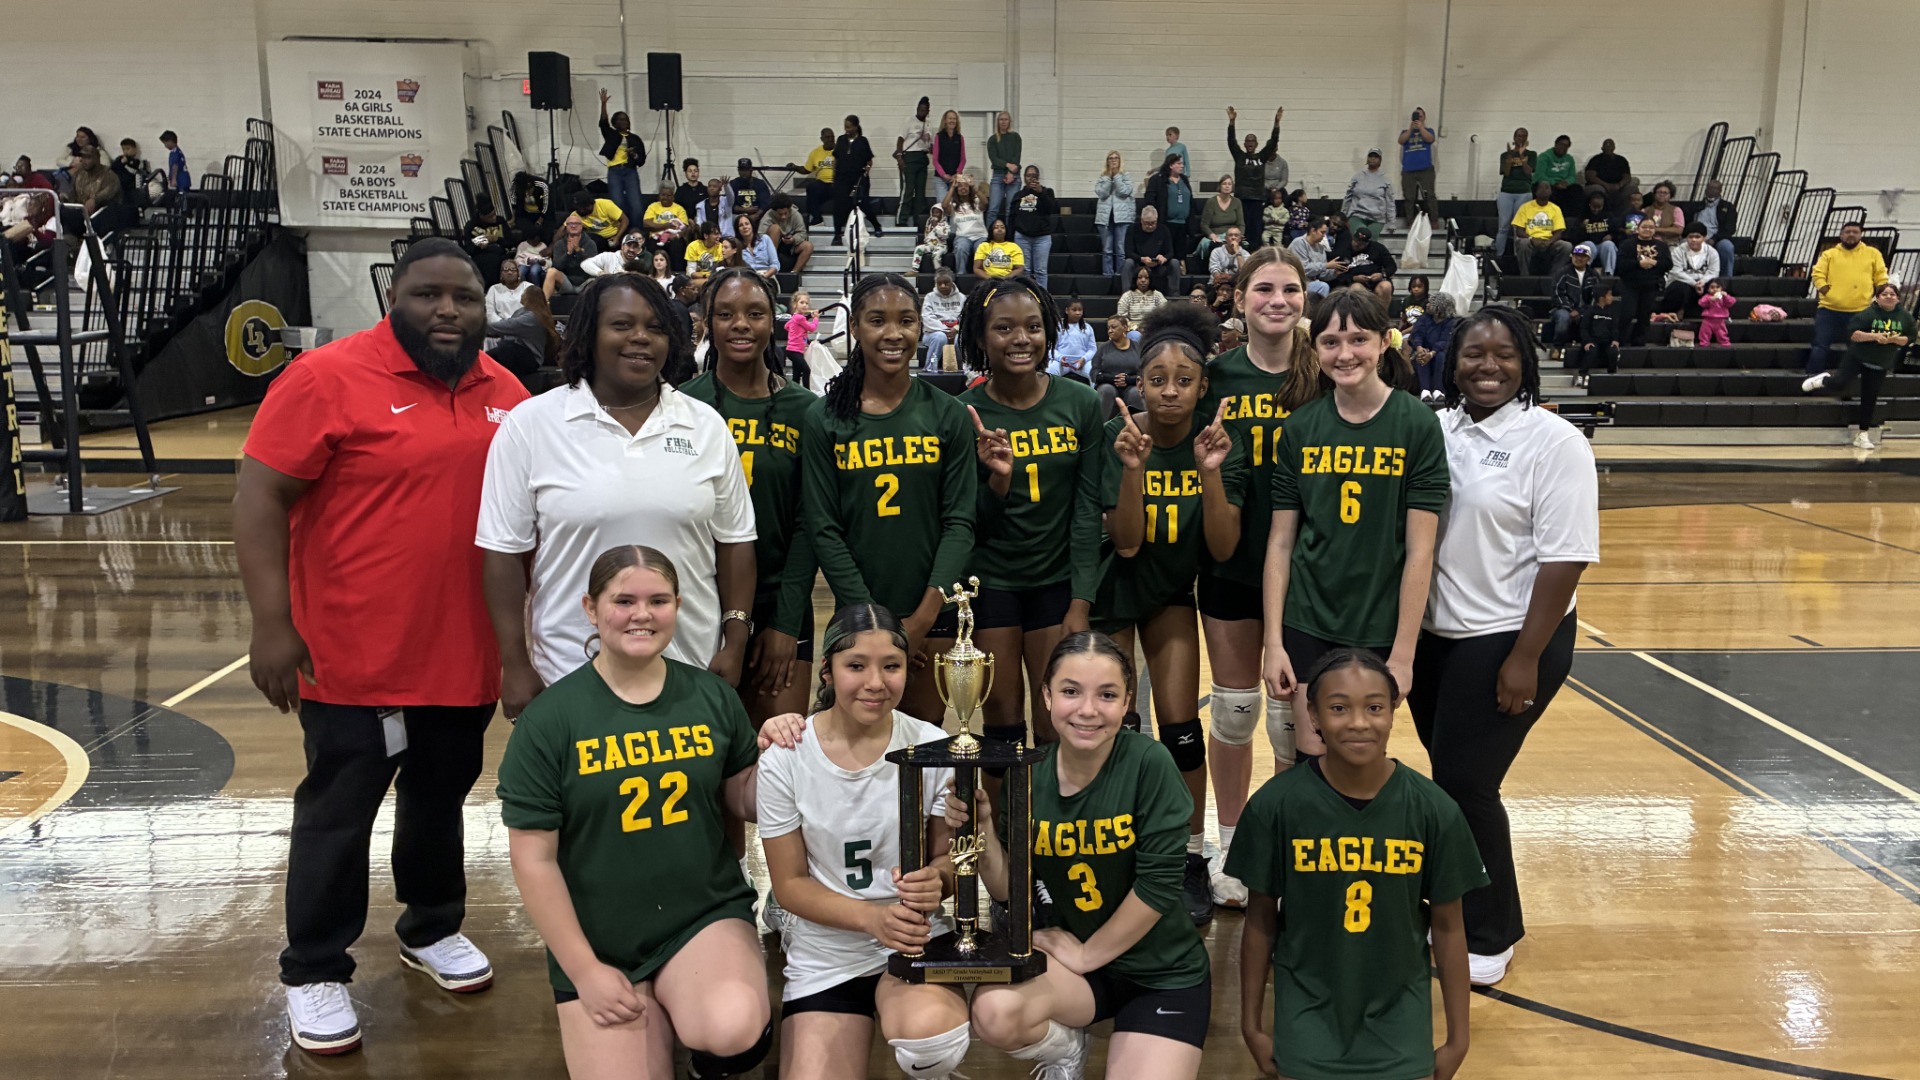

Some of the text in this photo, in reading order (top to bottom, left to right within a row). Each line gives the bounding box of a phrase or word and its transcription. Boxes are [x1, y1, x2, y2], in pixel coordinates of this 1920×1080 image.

[345, 102, 393, 113] 6A GIRLS
[354, 90, 382, 99] 2024
[318, 127, 422, 139] STATE CHAMPIONS
[335, 114, 404, 126] BASKETBALL
[350, 177, 396, 187] 6A BOYS
[359, 165, 386, 174] 2024
[322, 201, 426, 213] STATE CHAMPIONS
[339, 189, 408, 200] BASKETBALL
[1221, 393, 1291, 420] EAGL
[663, 446, 700, 457] VOLLEYBALL
[665, 437, 694, 450] FHSA
[727, 417, 800, 454] GLES
[1010, 426, 1079, 458] GLES
[834, 435, 941, 470] EAGLES
[1301, 445, 1407, 476] EAGLES
[1486, 450, 1511, 462] FHSA
[874, 473, 901, 518] 2
[1025, 462, 1041, 503] 1
[1340, 480, 1362, 524] 6
[1145, 503, 1179, 544] 11
[575, 724, 715, 776] EAGLES
[618, 770, 689, 833] 22
[1032, 813, 1136, 857] AGLES
[844, 839, 874, 891] 5
[1292, 836, 1425, 875] EAGLES
[1067, 862, 1104, 912] 3
[1343, 880, 1373, 933] 8
